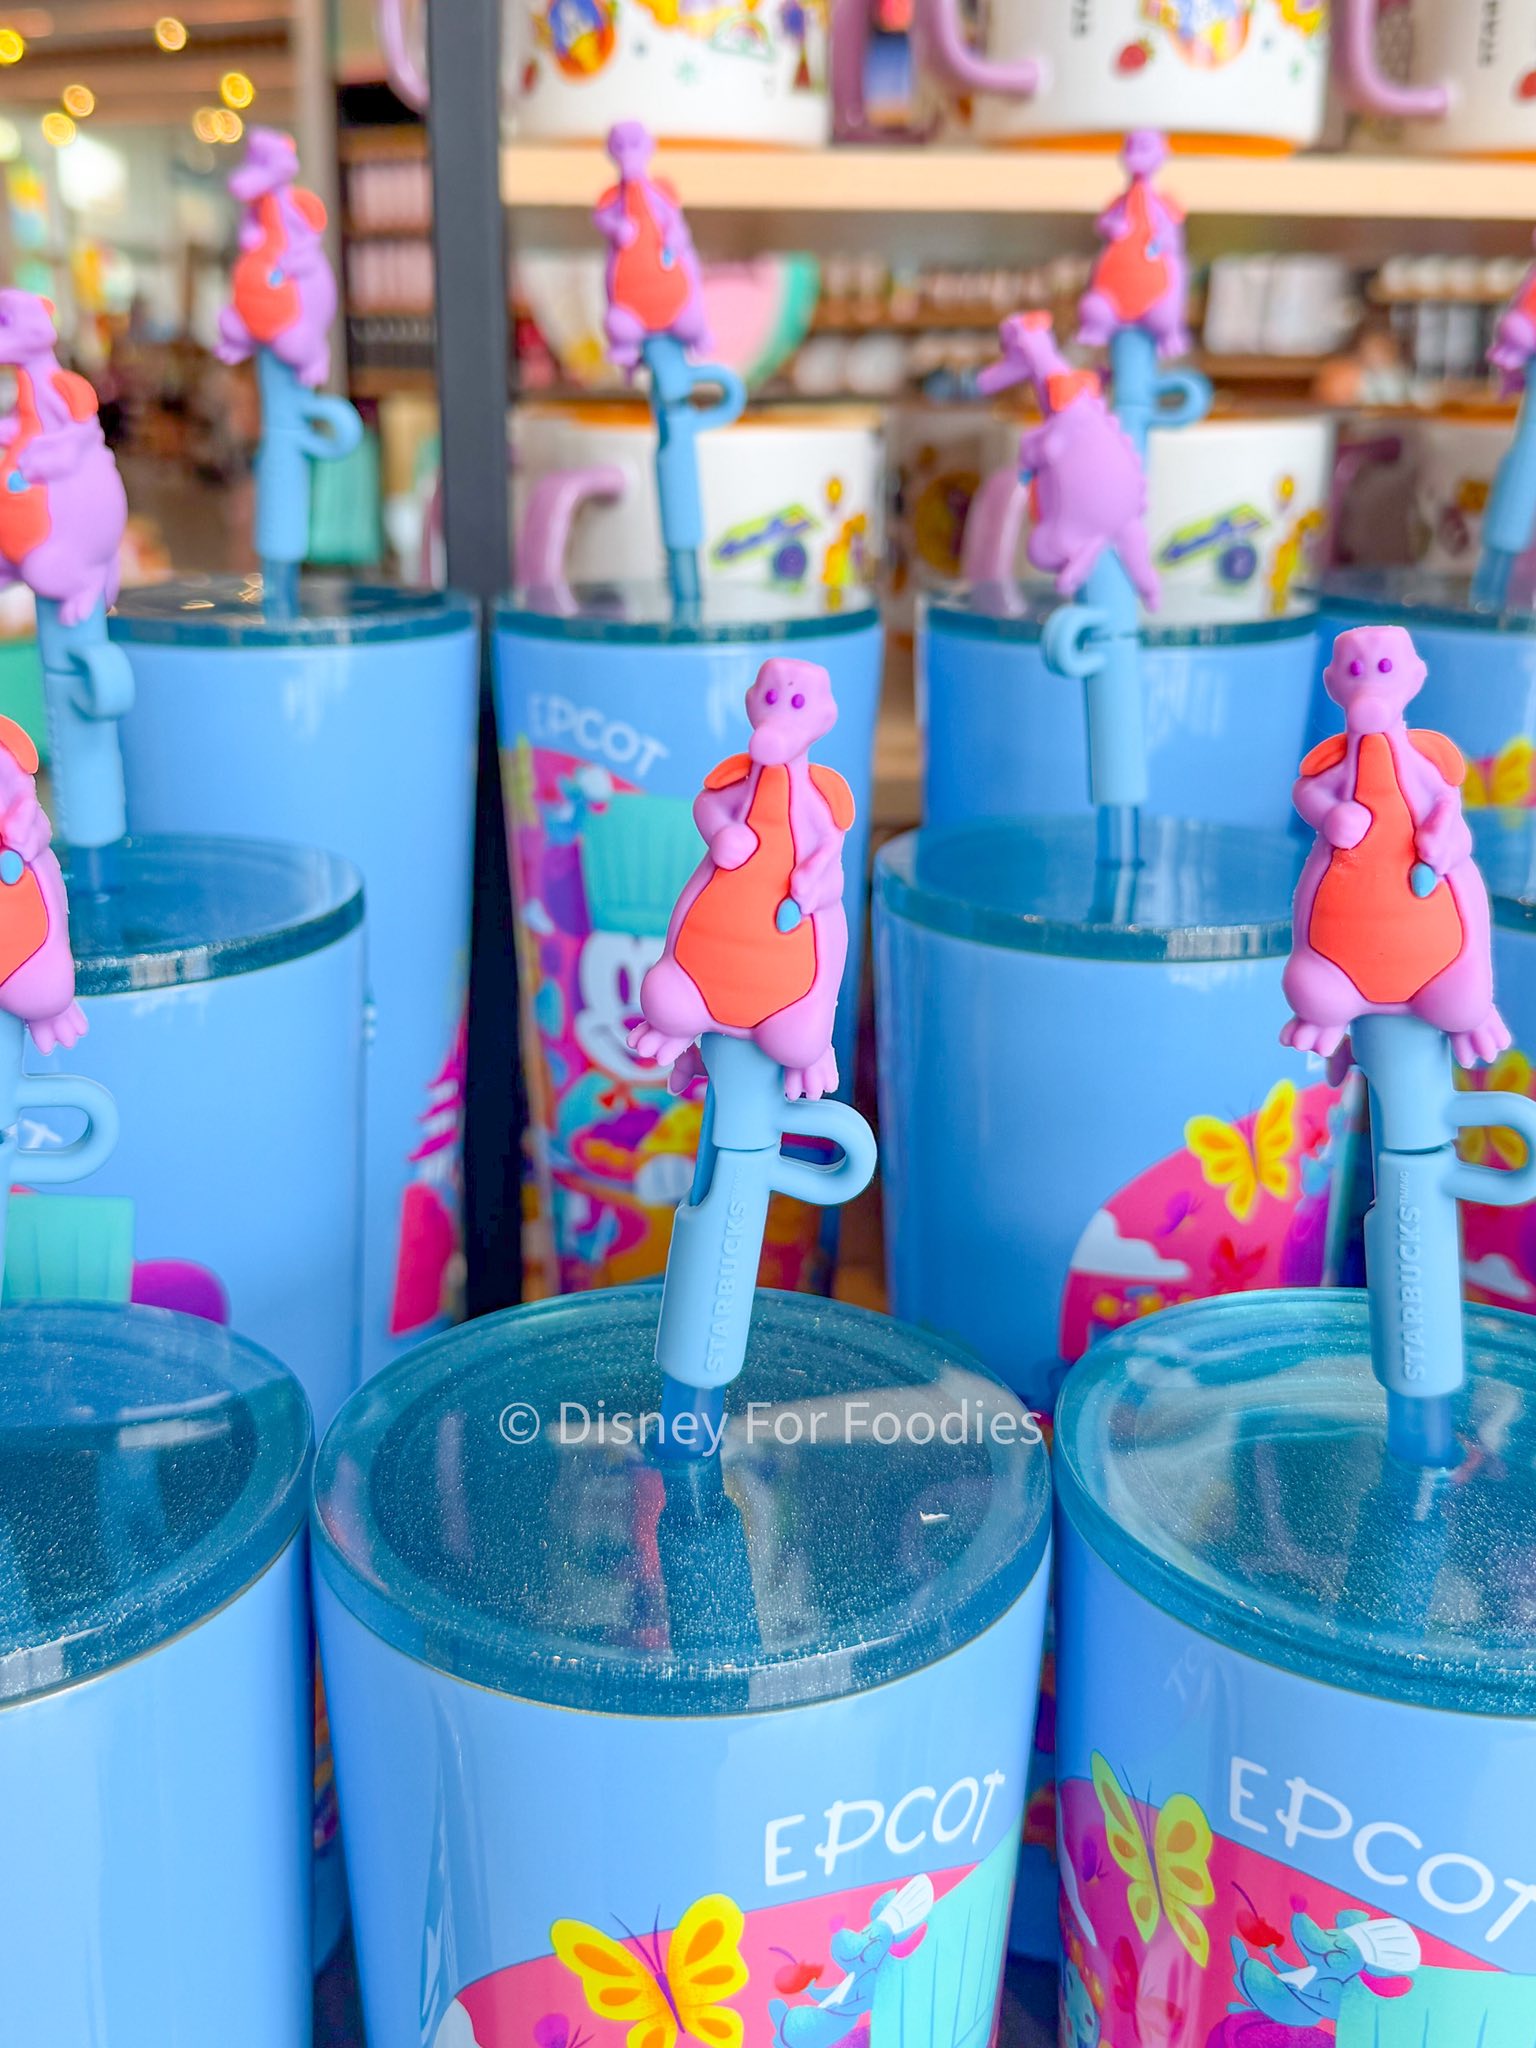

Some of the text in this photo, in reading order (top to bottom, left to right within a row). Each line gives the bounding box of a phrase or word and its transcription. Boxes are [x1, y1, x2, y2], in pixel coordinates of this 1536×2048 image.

[527, 692, 669, 777] EPCOT
[704, 1200, 746, 1374] STARBUCKS
[1399, 1206, 1425, 1381] STARBUCKS
[765, 1769, 1006, 1886] EPCOT
[1229, 1756, 1536, 1942] EPCOT
